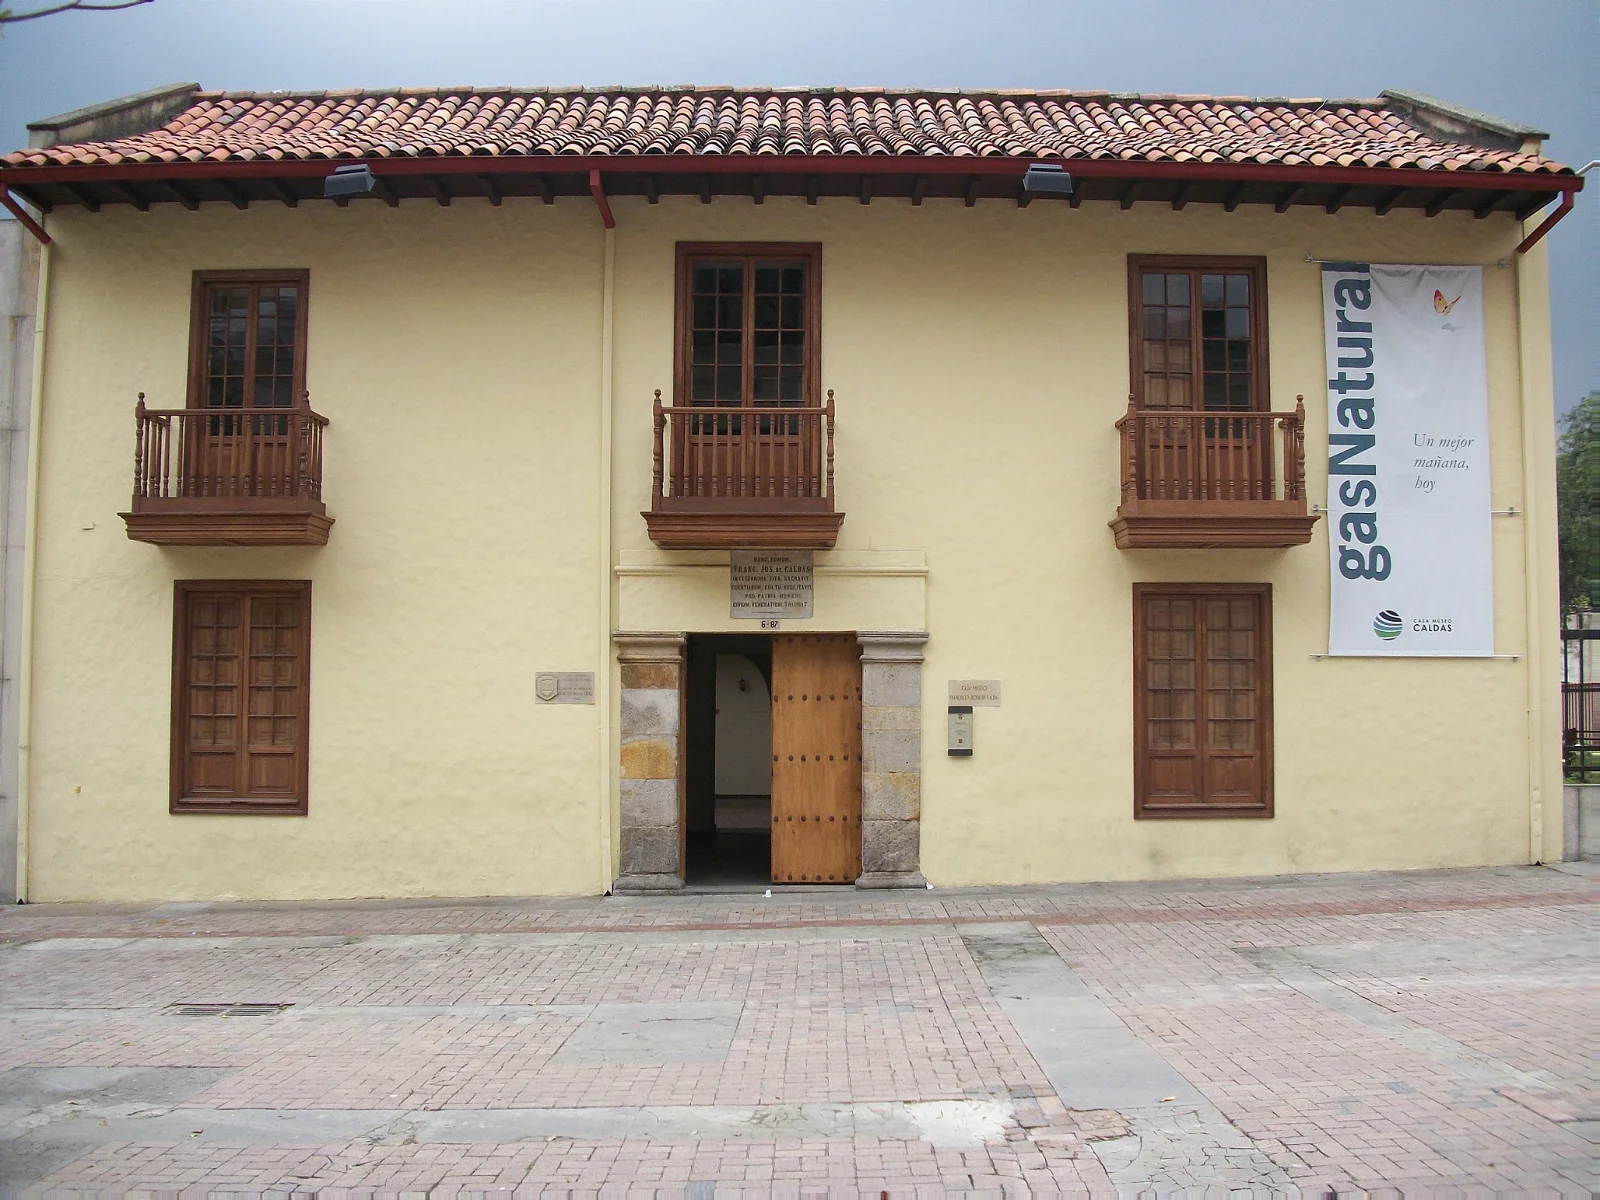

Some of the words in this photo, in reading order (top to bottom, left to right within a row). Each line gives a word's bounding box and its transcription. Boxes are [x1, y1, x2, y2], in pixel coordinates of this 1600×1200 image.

[1321, 262, 1392, 582] gasNatural
[1413, 433, 1435, 447] Un
[1438, 435, 1475, 452] mejor
[1413, 455, 1469, 471] mañana,
[1414, 475, 1436, 494] hoy
[761, 620, 779, 629] 6-87
[1413, 624, 1452, 632] CALDAS
